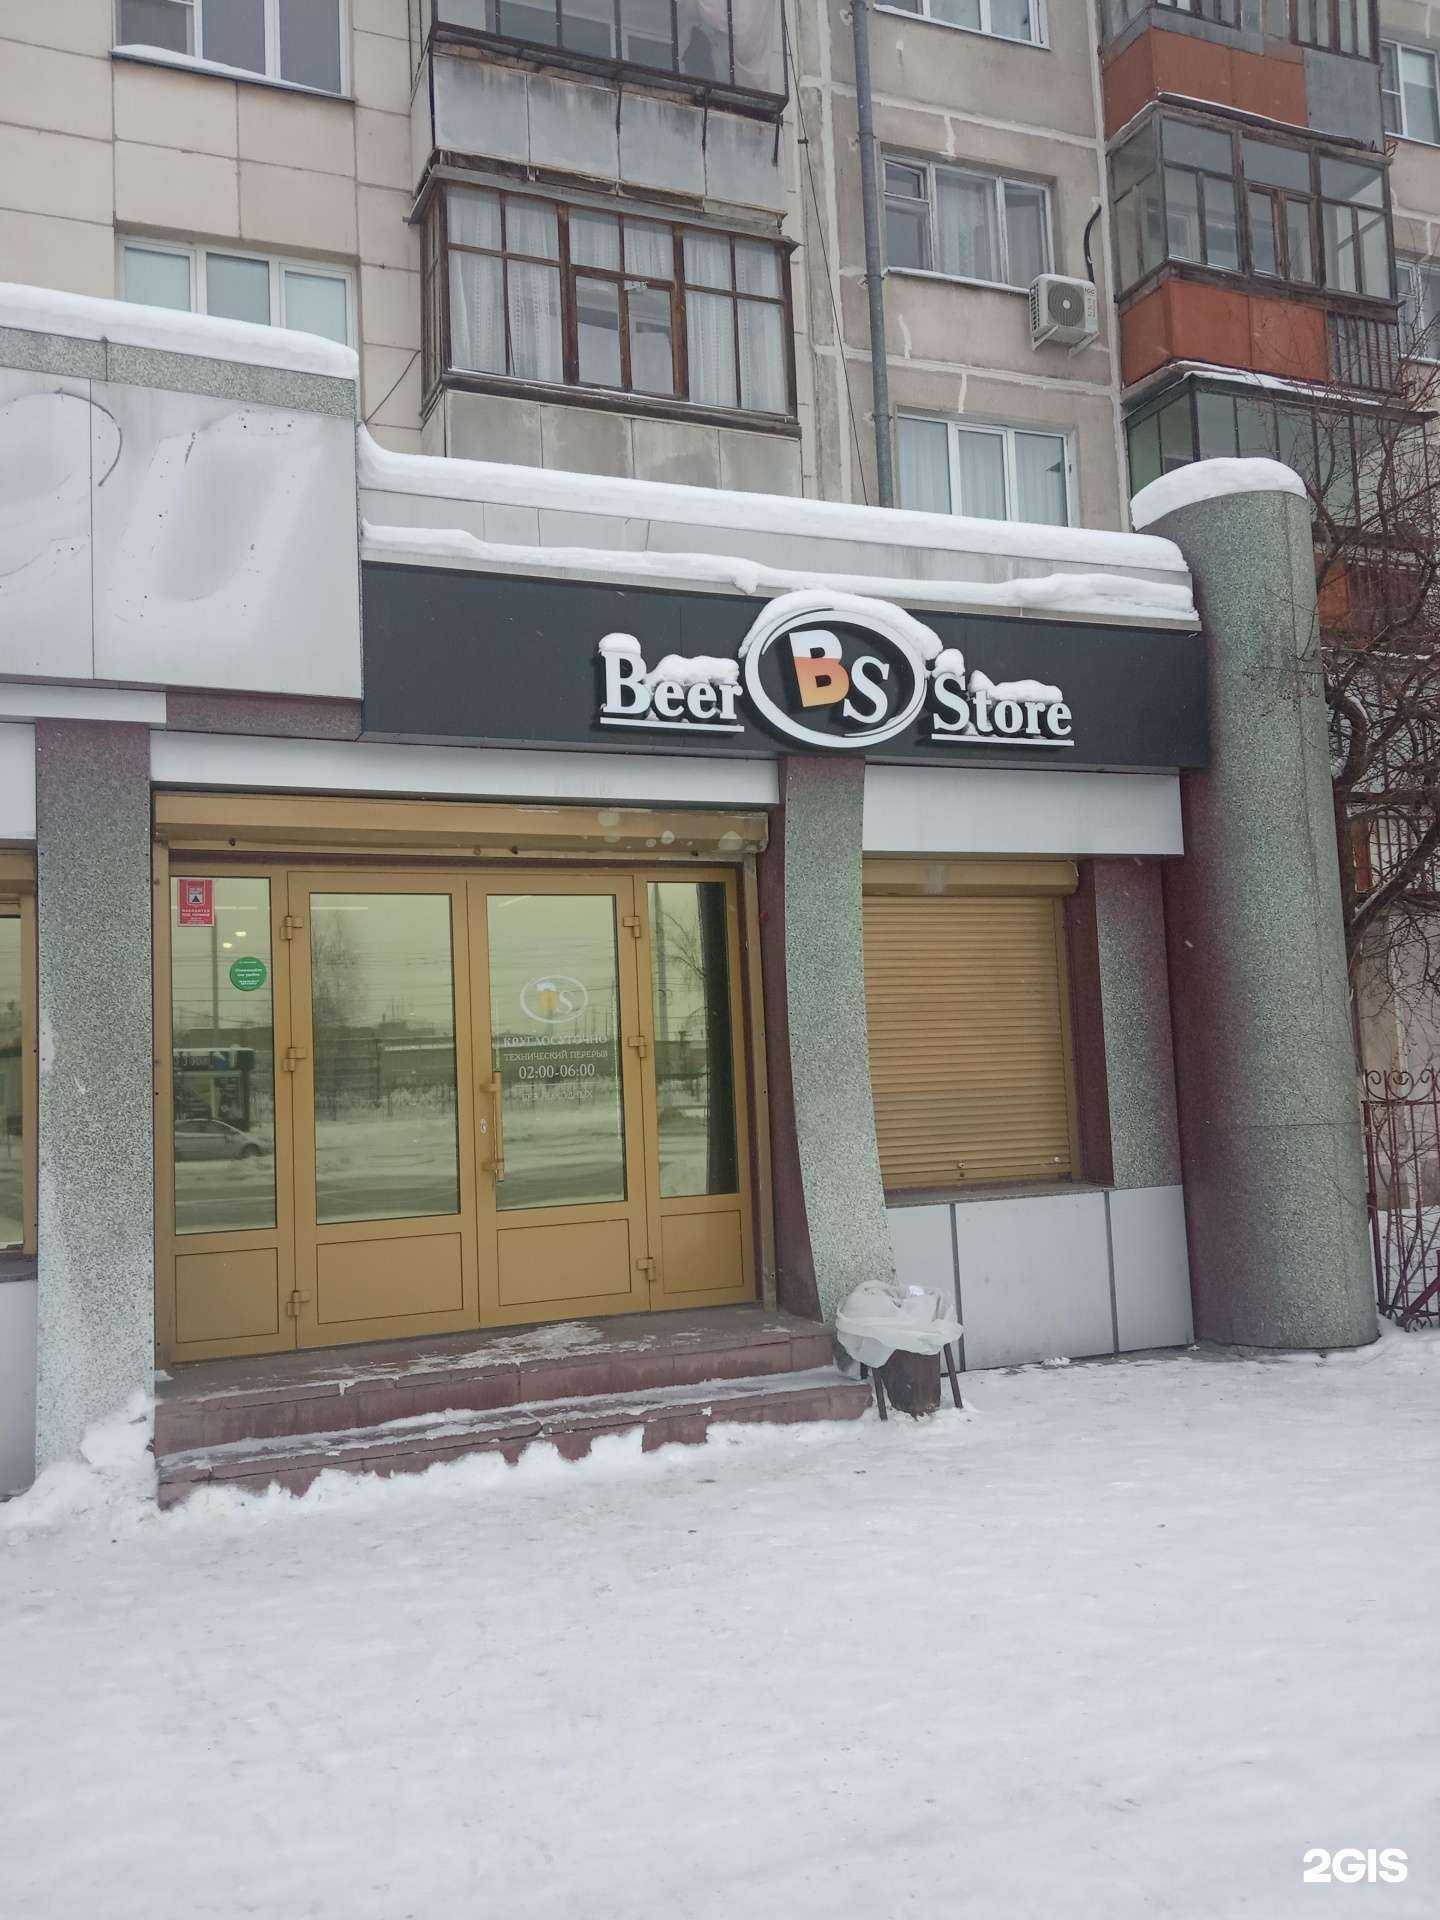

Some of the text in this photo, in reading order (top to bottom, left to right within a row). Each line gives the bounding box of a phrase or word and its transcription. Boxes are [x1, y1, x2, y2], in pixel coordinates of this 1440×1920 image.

[601, 629, 1073, 736] Beer BS Store
[503, 1049, 609, 1062] ТЕХНИЧЕСКИЙ ПЕРЕРЫВ
[518, 1063, 596, 1080] 02:00-06:00
